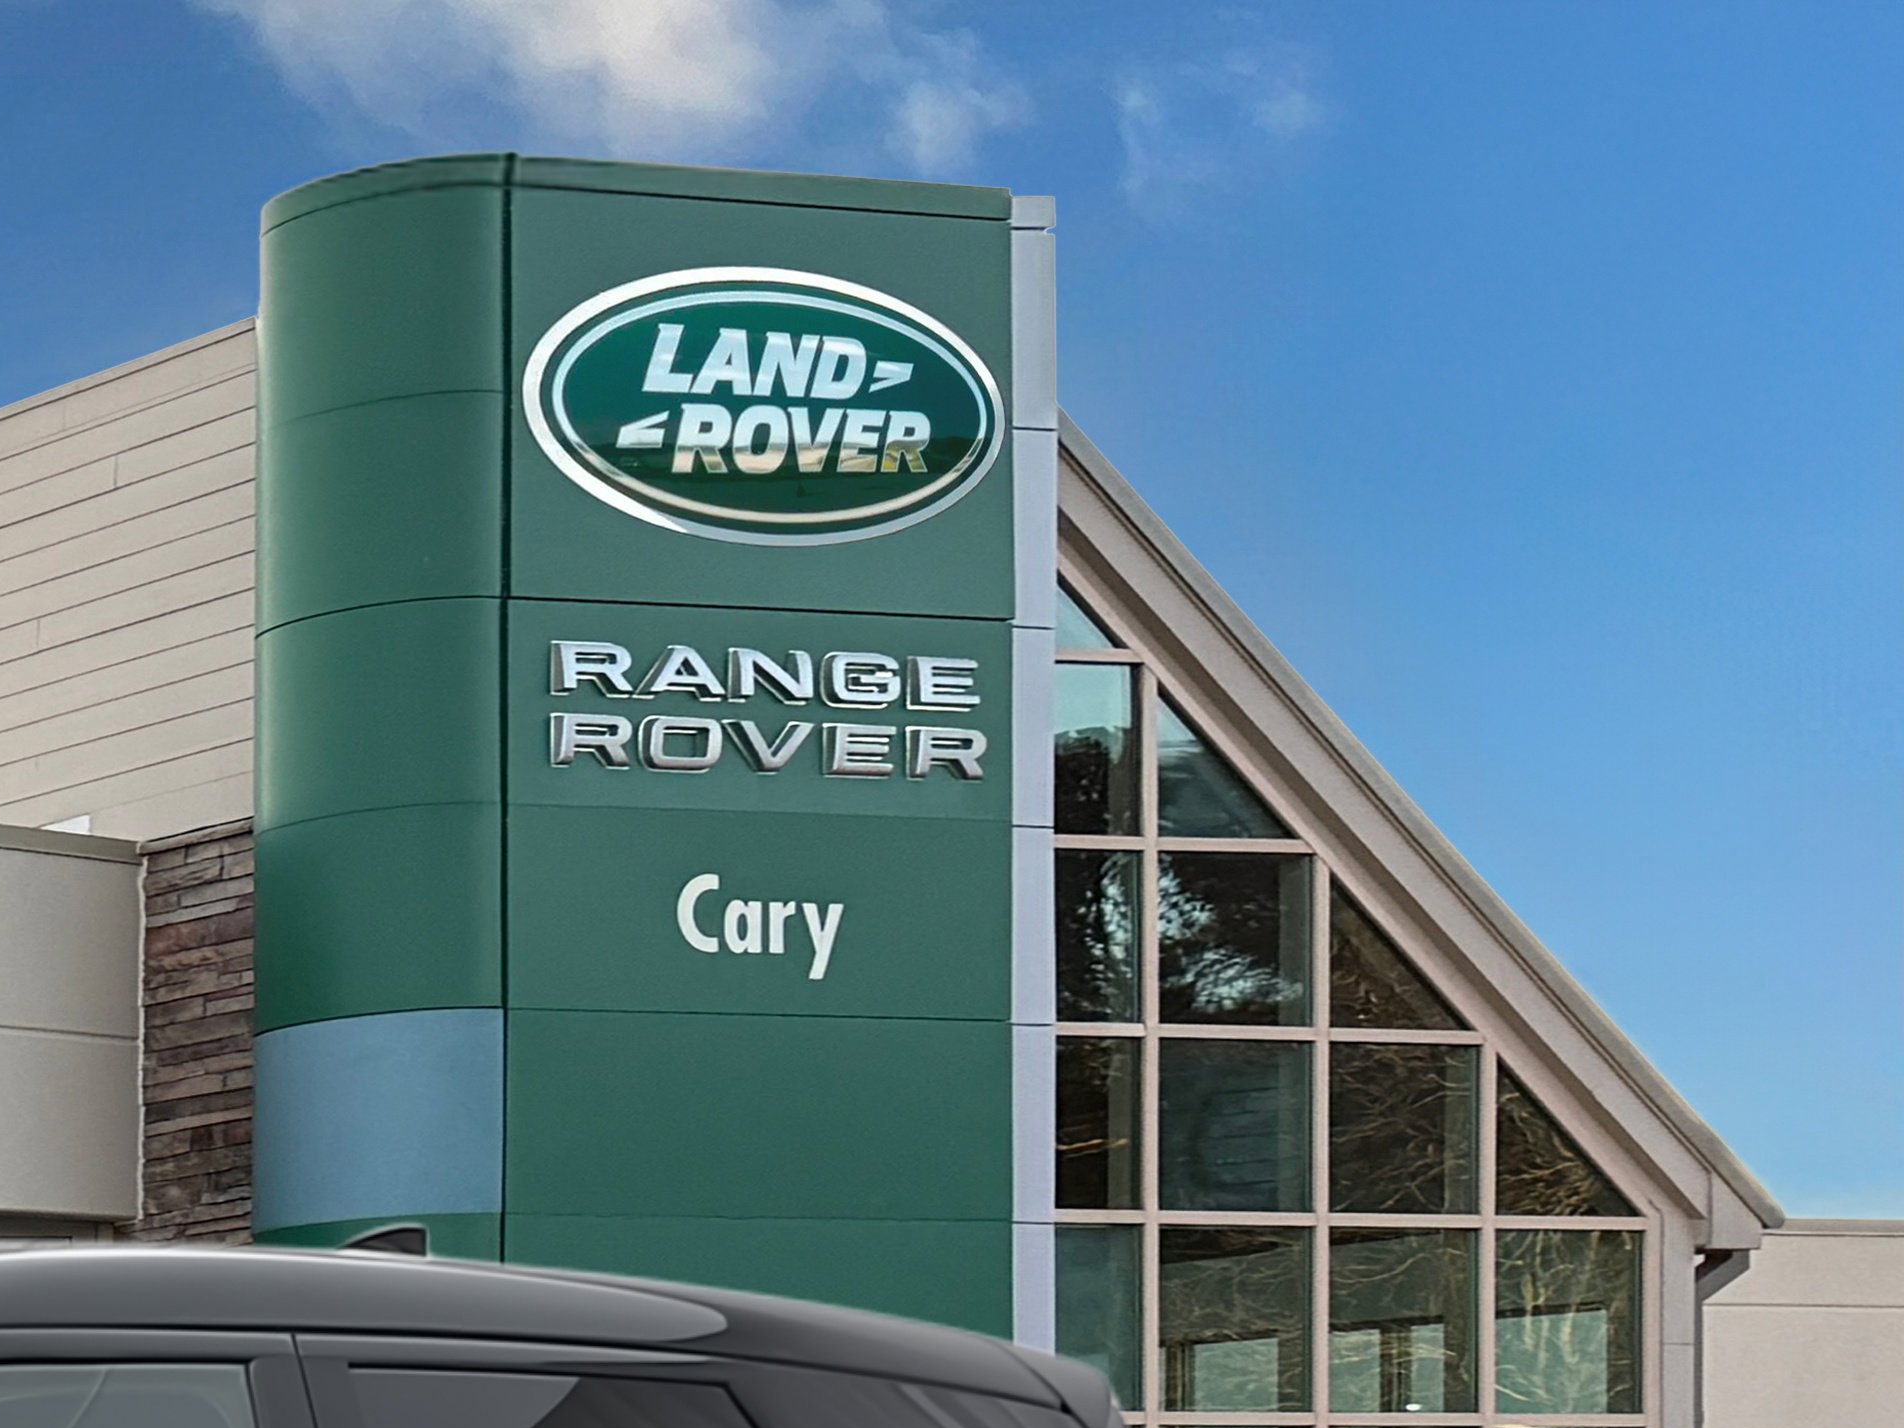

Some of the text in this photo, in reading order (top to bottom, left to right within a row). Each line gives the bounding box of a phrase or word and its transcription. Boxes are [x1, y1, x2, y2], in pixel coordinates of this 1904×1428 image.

[642, 323, 868, 400] LAND
[672, 403, 932, 474] ROVER
[550, 640, 981, 712] RANGE
[550, 712, 988, 781] ROVER
[677, 873, 844, 980] Cary
